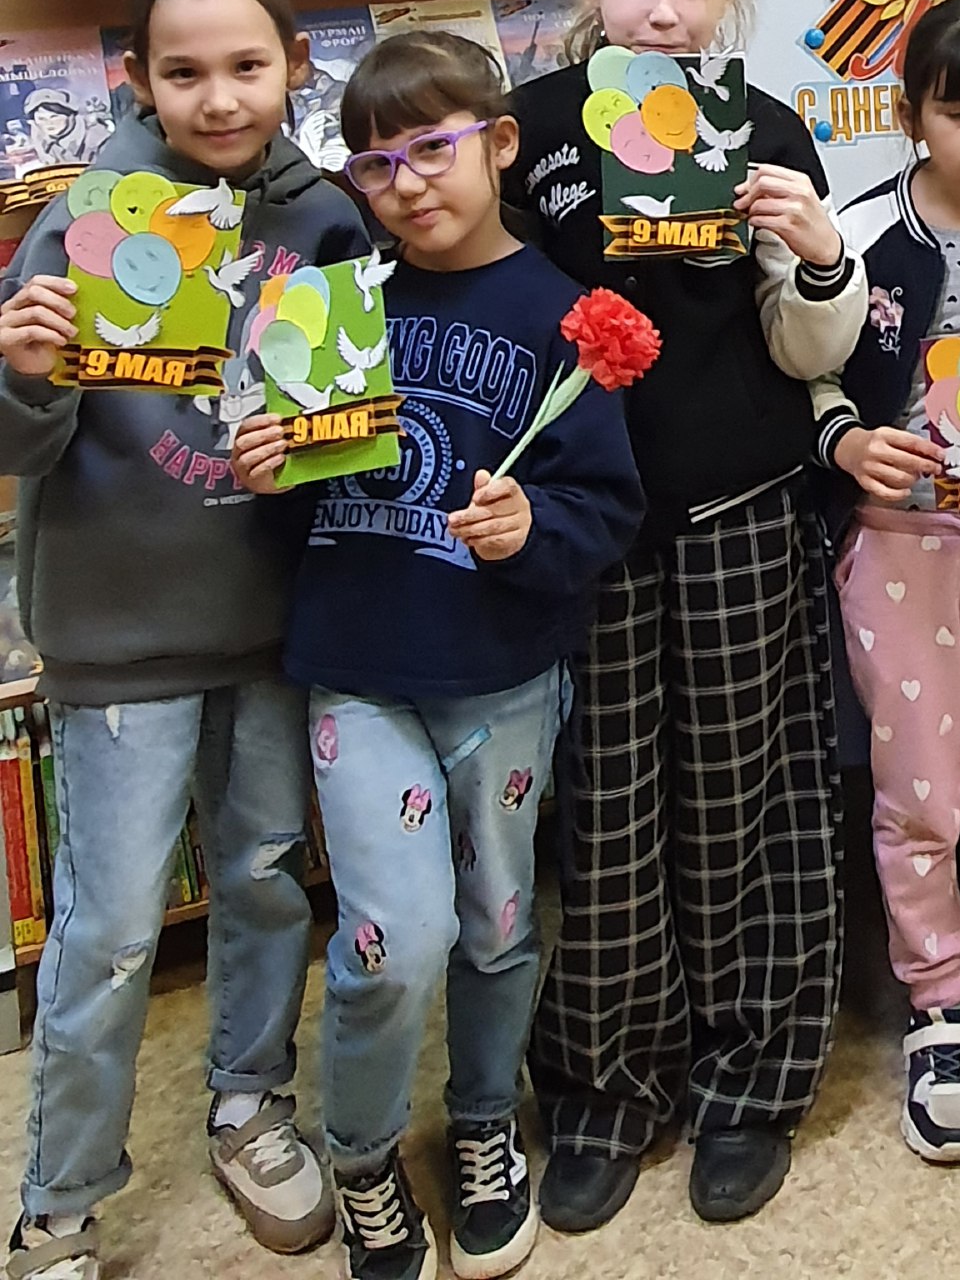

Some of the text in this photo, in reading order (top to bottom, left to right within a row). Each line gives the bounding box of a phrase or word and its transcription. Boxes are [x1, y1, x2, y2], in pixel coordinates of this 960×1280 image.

[632, 219, 717, 248] 9 МАЯ
[86, 350, 185, 386] 9 МАЯ
[438, 322, 536, 440] GOOD
[293, 410, 369, 443] 9 МАЯ
